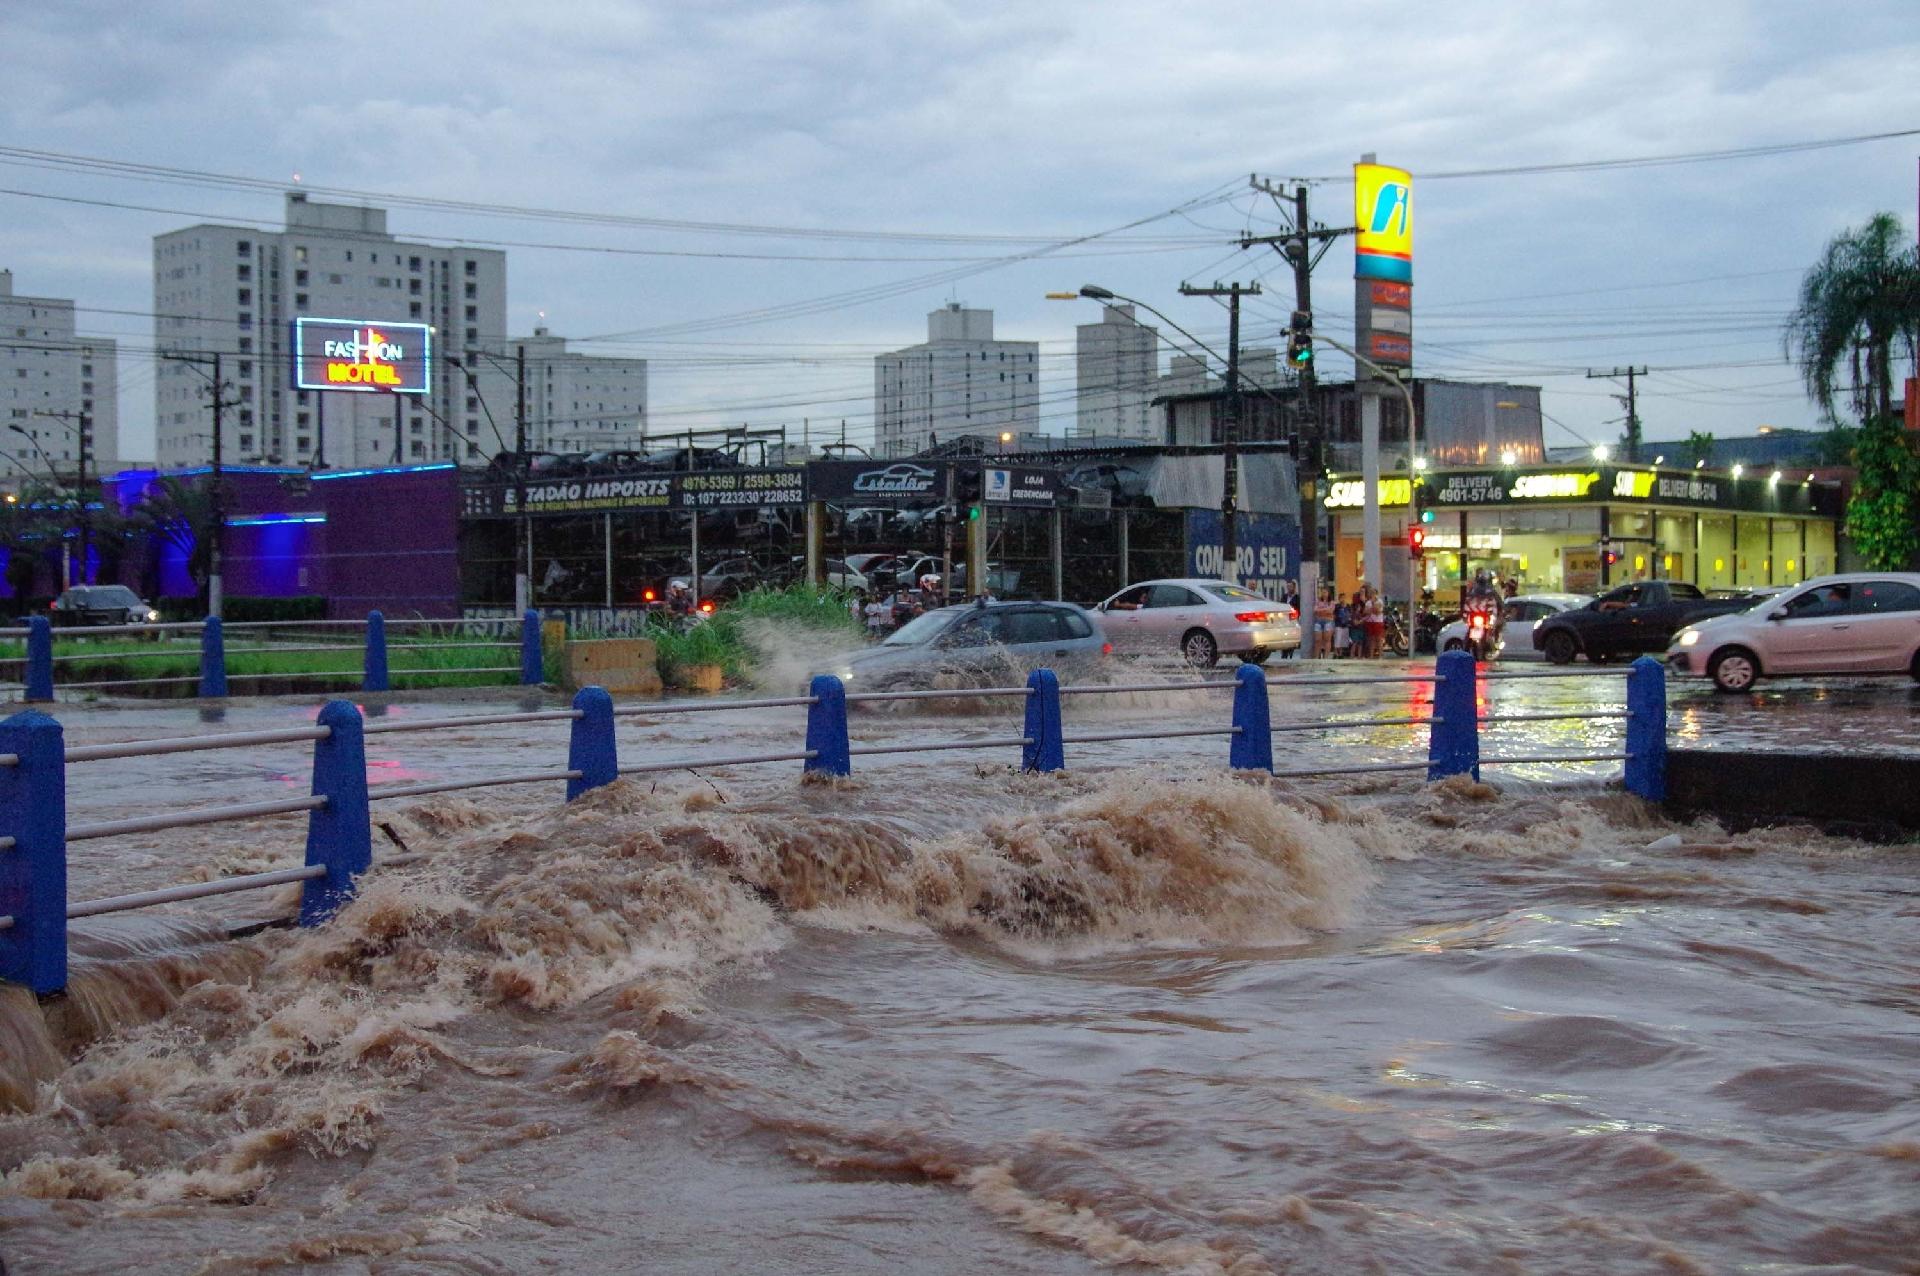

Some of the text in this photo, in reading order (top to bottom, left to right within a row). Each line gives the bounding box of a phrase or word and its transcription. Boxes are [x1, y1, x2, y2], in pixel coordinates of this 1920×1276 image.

[324, 328, 402, 364] FASHION
[328, 363, 401, 384] MOTEL
[1024, 475, 1044, 486] LOJA
[1449, 477, 1493, 488] DELIVERY
[505, 479, 671, 504] ETADÃO IMPORTS
[1439, 487, 1502, 502] 4901-5746
[1195, 545, 1286, 575] COMRO SEU
